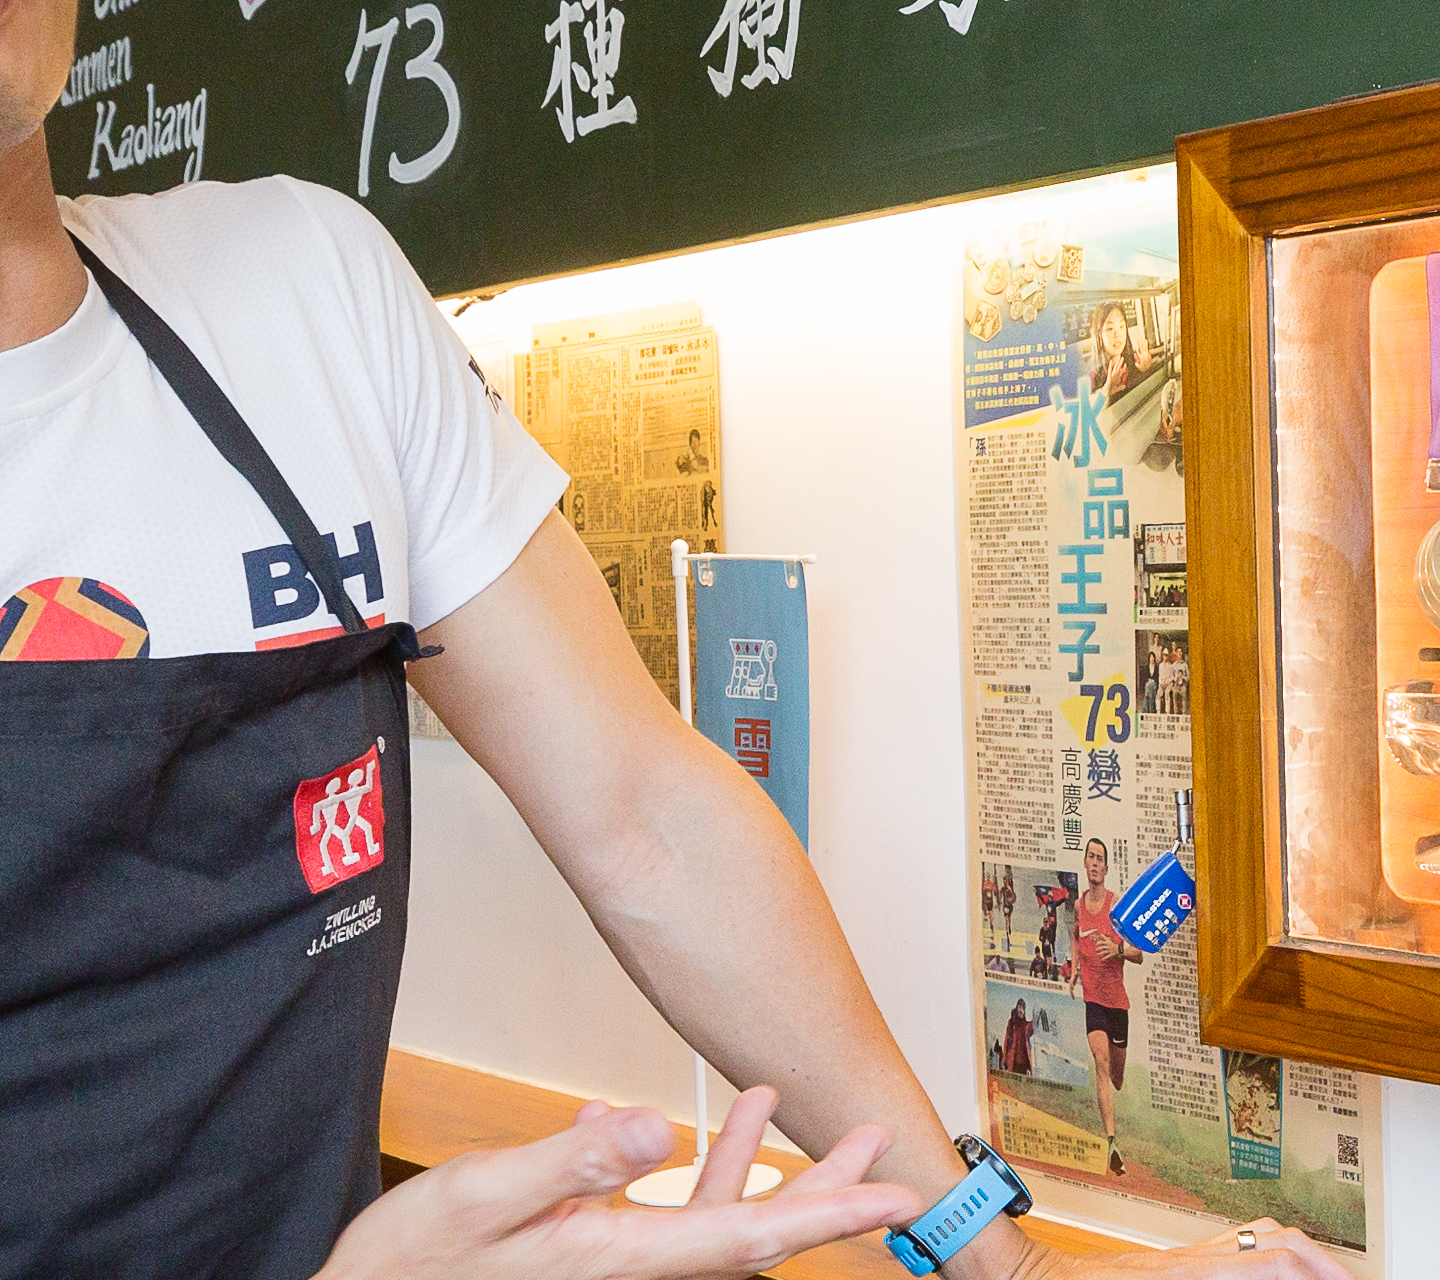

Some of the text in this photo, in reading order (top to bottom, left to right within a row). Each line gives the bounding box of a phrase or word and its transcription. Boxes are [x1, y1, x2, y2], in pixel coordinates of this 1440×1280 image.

[87, 83, 208, 184] Kaoliang
[241, 520, 385, 630] BH
[1049, 377, 1130, 682] 冰品王子
[734, 717, 772, 778] 雪
[1060, 747, 1084, 852] 高慶豐
[323, 894, 377, 932] ZWILLING
[1131, 888, 1173, 931] Master
